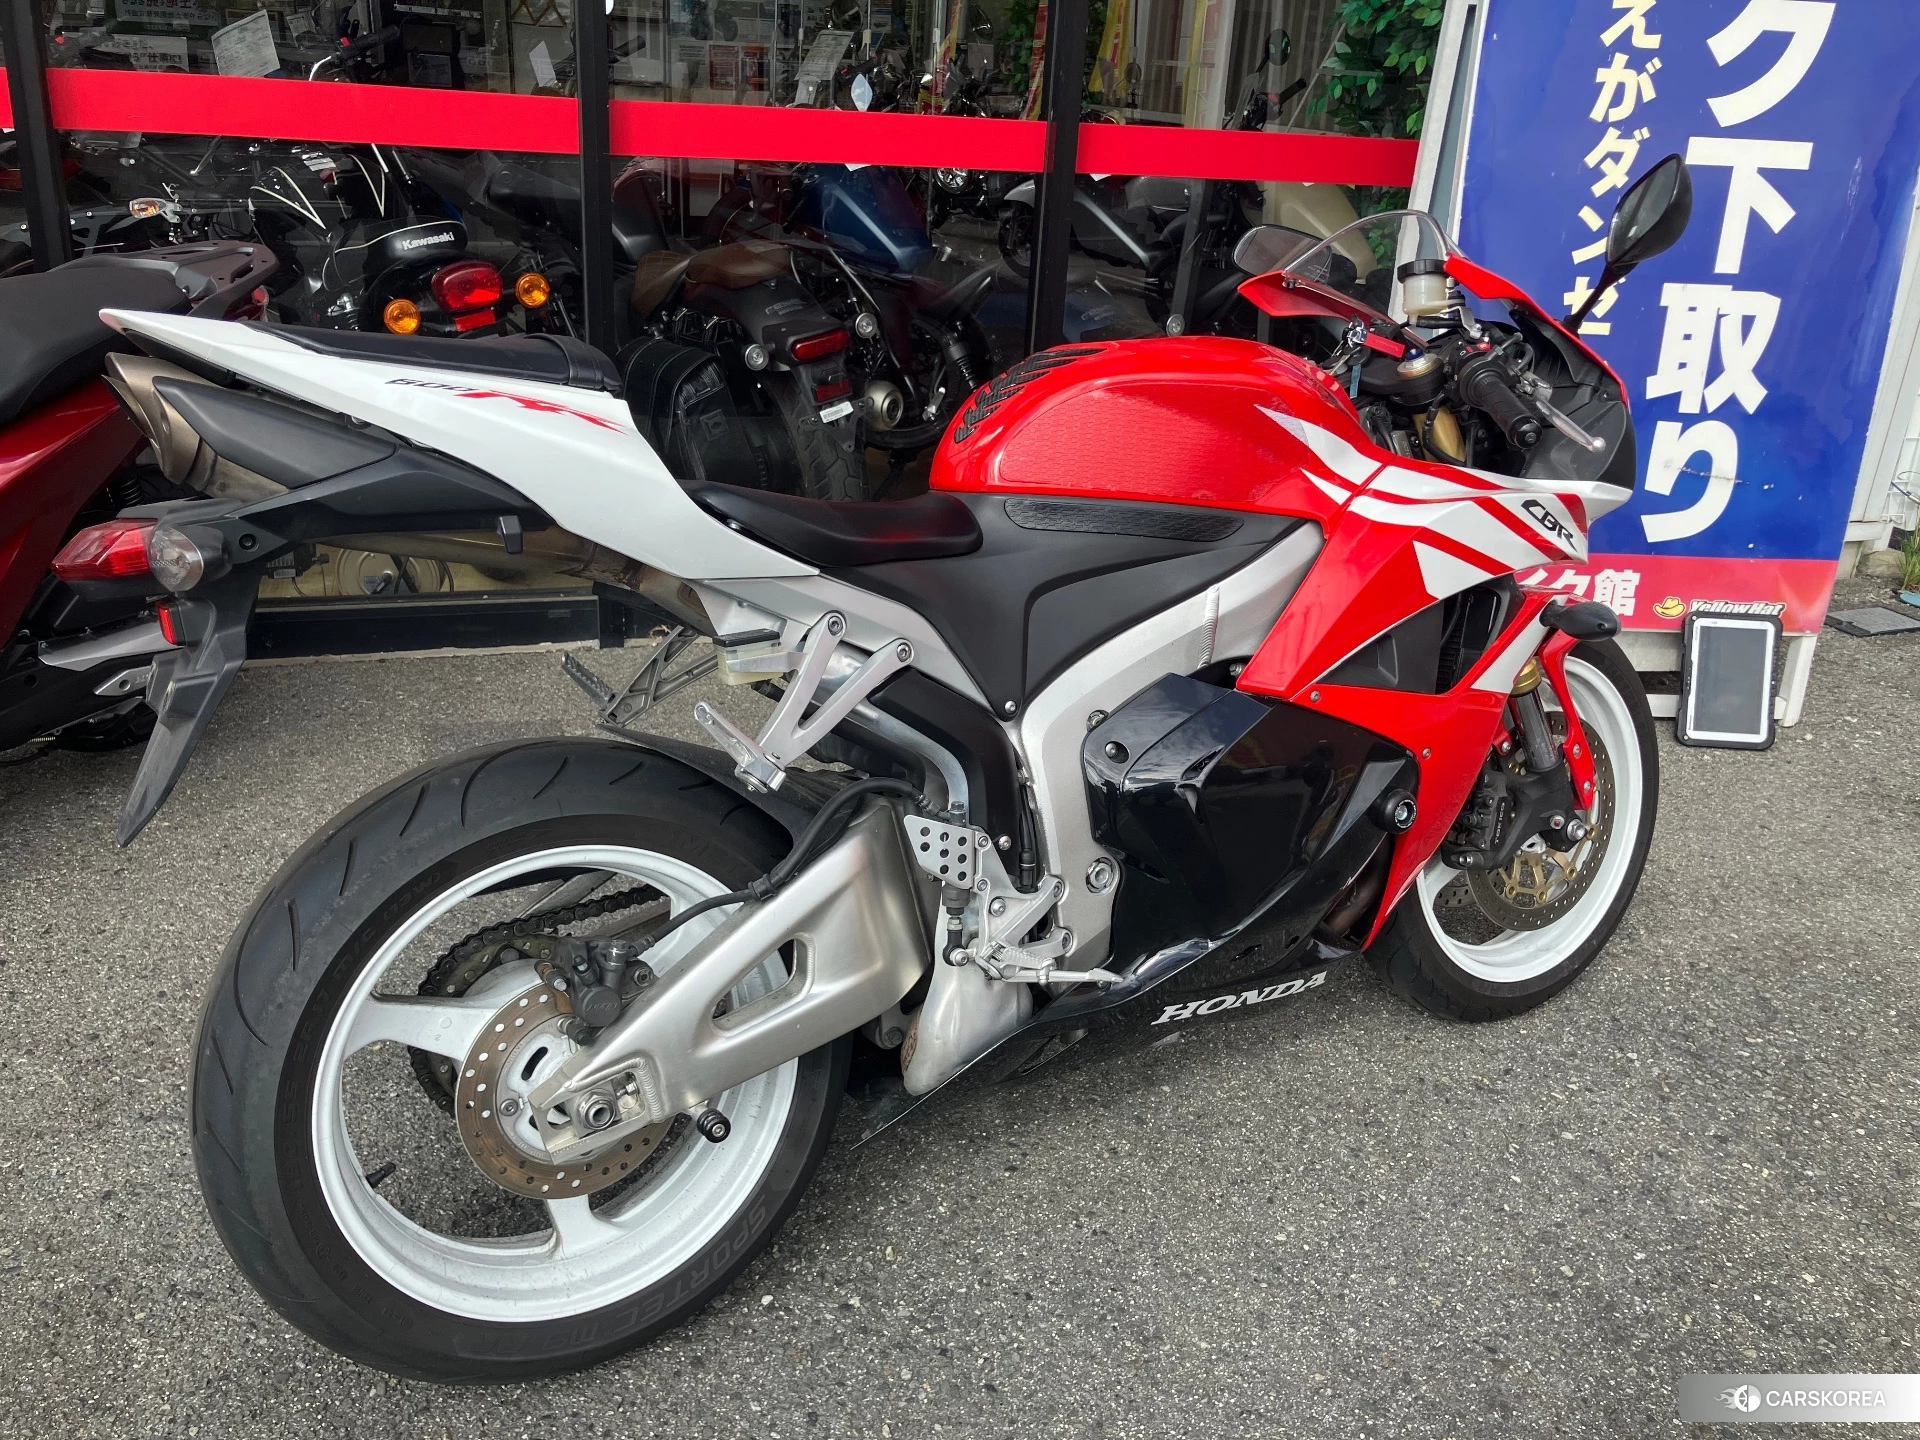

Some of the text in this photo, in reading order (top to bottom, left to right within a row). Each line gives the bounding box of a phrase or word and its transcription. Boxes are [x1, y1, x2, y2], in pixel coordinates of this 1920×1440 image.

[402, 231, 455, 250] Kawasaki
[1640, 0, 1837, 543] ク下取り
[1521, 499, 1577, 552] CBR
[1150, 971, 1327, 1025] HONDA
